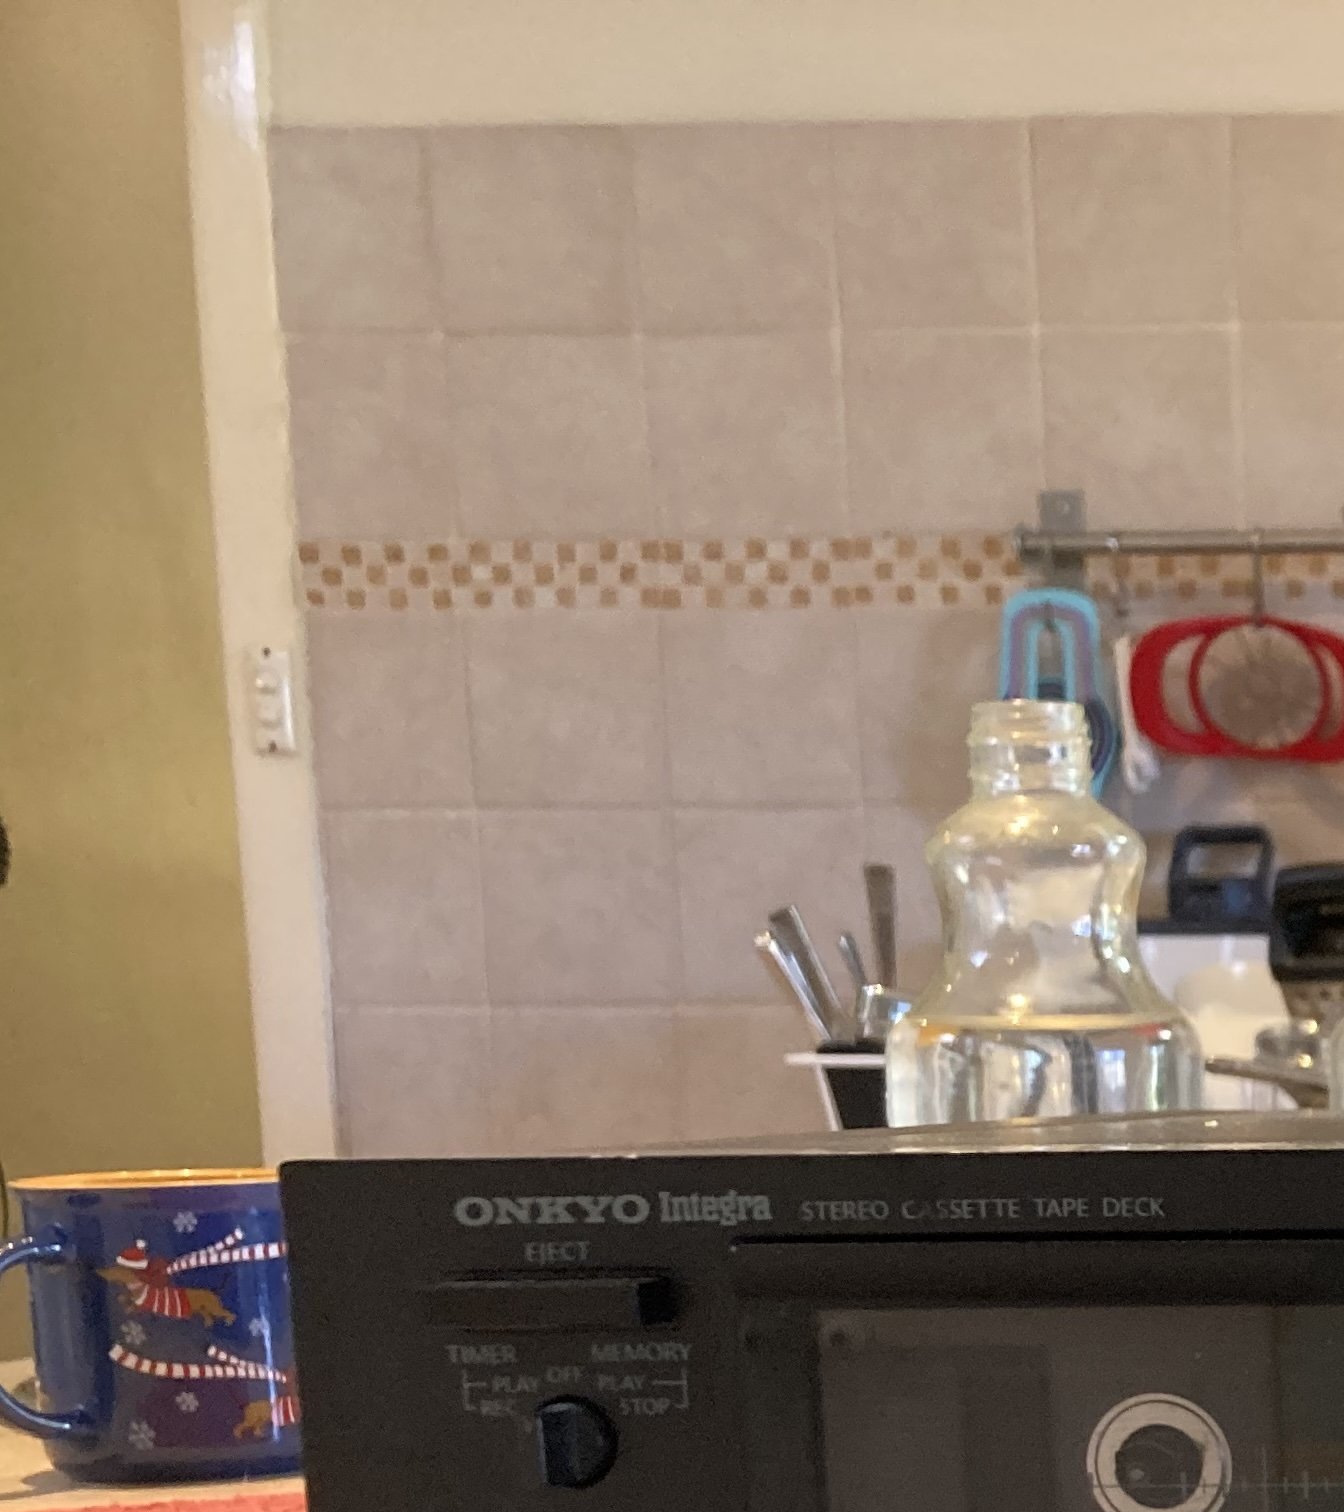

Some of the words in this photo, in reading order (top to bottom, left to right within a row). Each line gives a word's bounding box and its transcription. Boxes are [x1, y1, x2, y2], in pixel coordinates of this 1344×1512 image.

[453, 1193, 651, 1227] ONKYO
[657, 1189, 774, 1228] Integra
[800, 1200, 890, 1222] STEREO
[901, 1197, 1021, 1221] CASSETTE
[1034, 1197, 1089, 1219] TAPE
[1101, 1196, 1166, 1218] DECK
[523, 1239, 592, 1266] EJECT
[444, 1343, 518, 1365] TIMER
[591, 1342, 692, 1363] MEMORY
[493, 1374, 540, 1393] PLAY
[546, 1364, 586, 1384] OFF
[597, 1373, 647, 1392] PLAY
[618, 1398, 672, 1417] STOP
